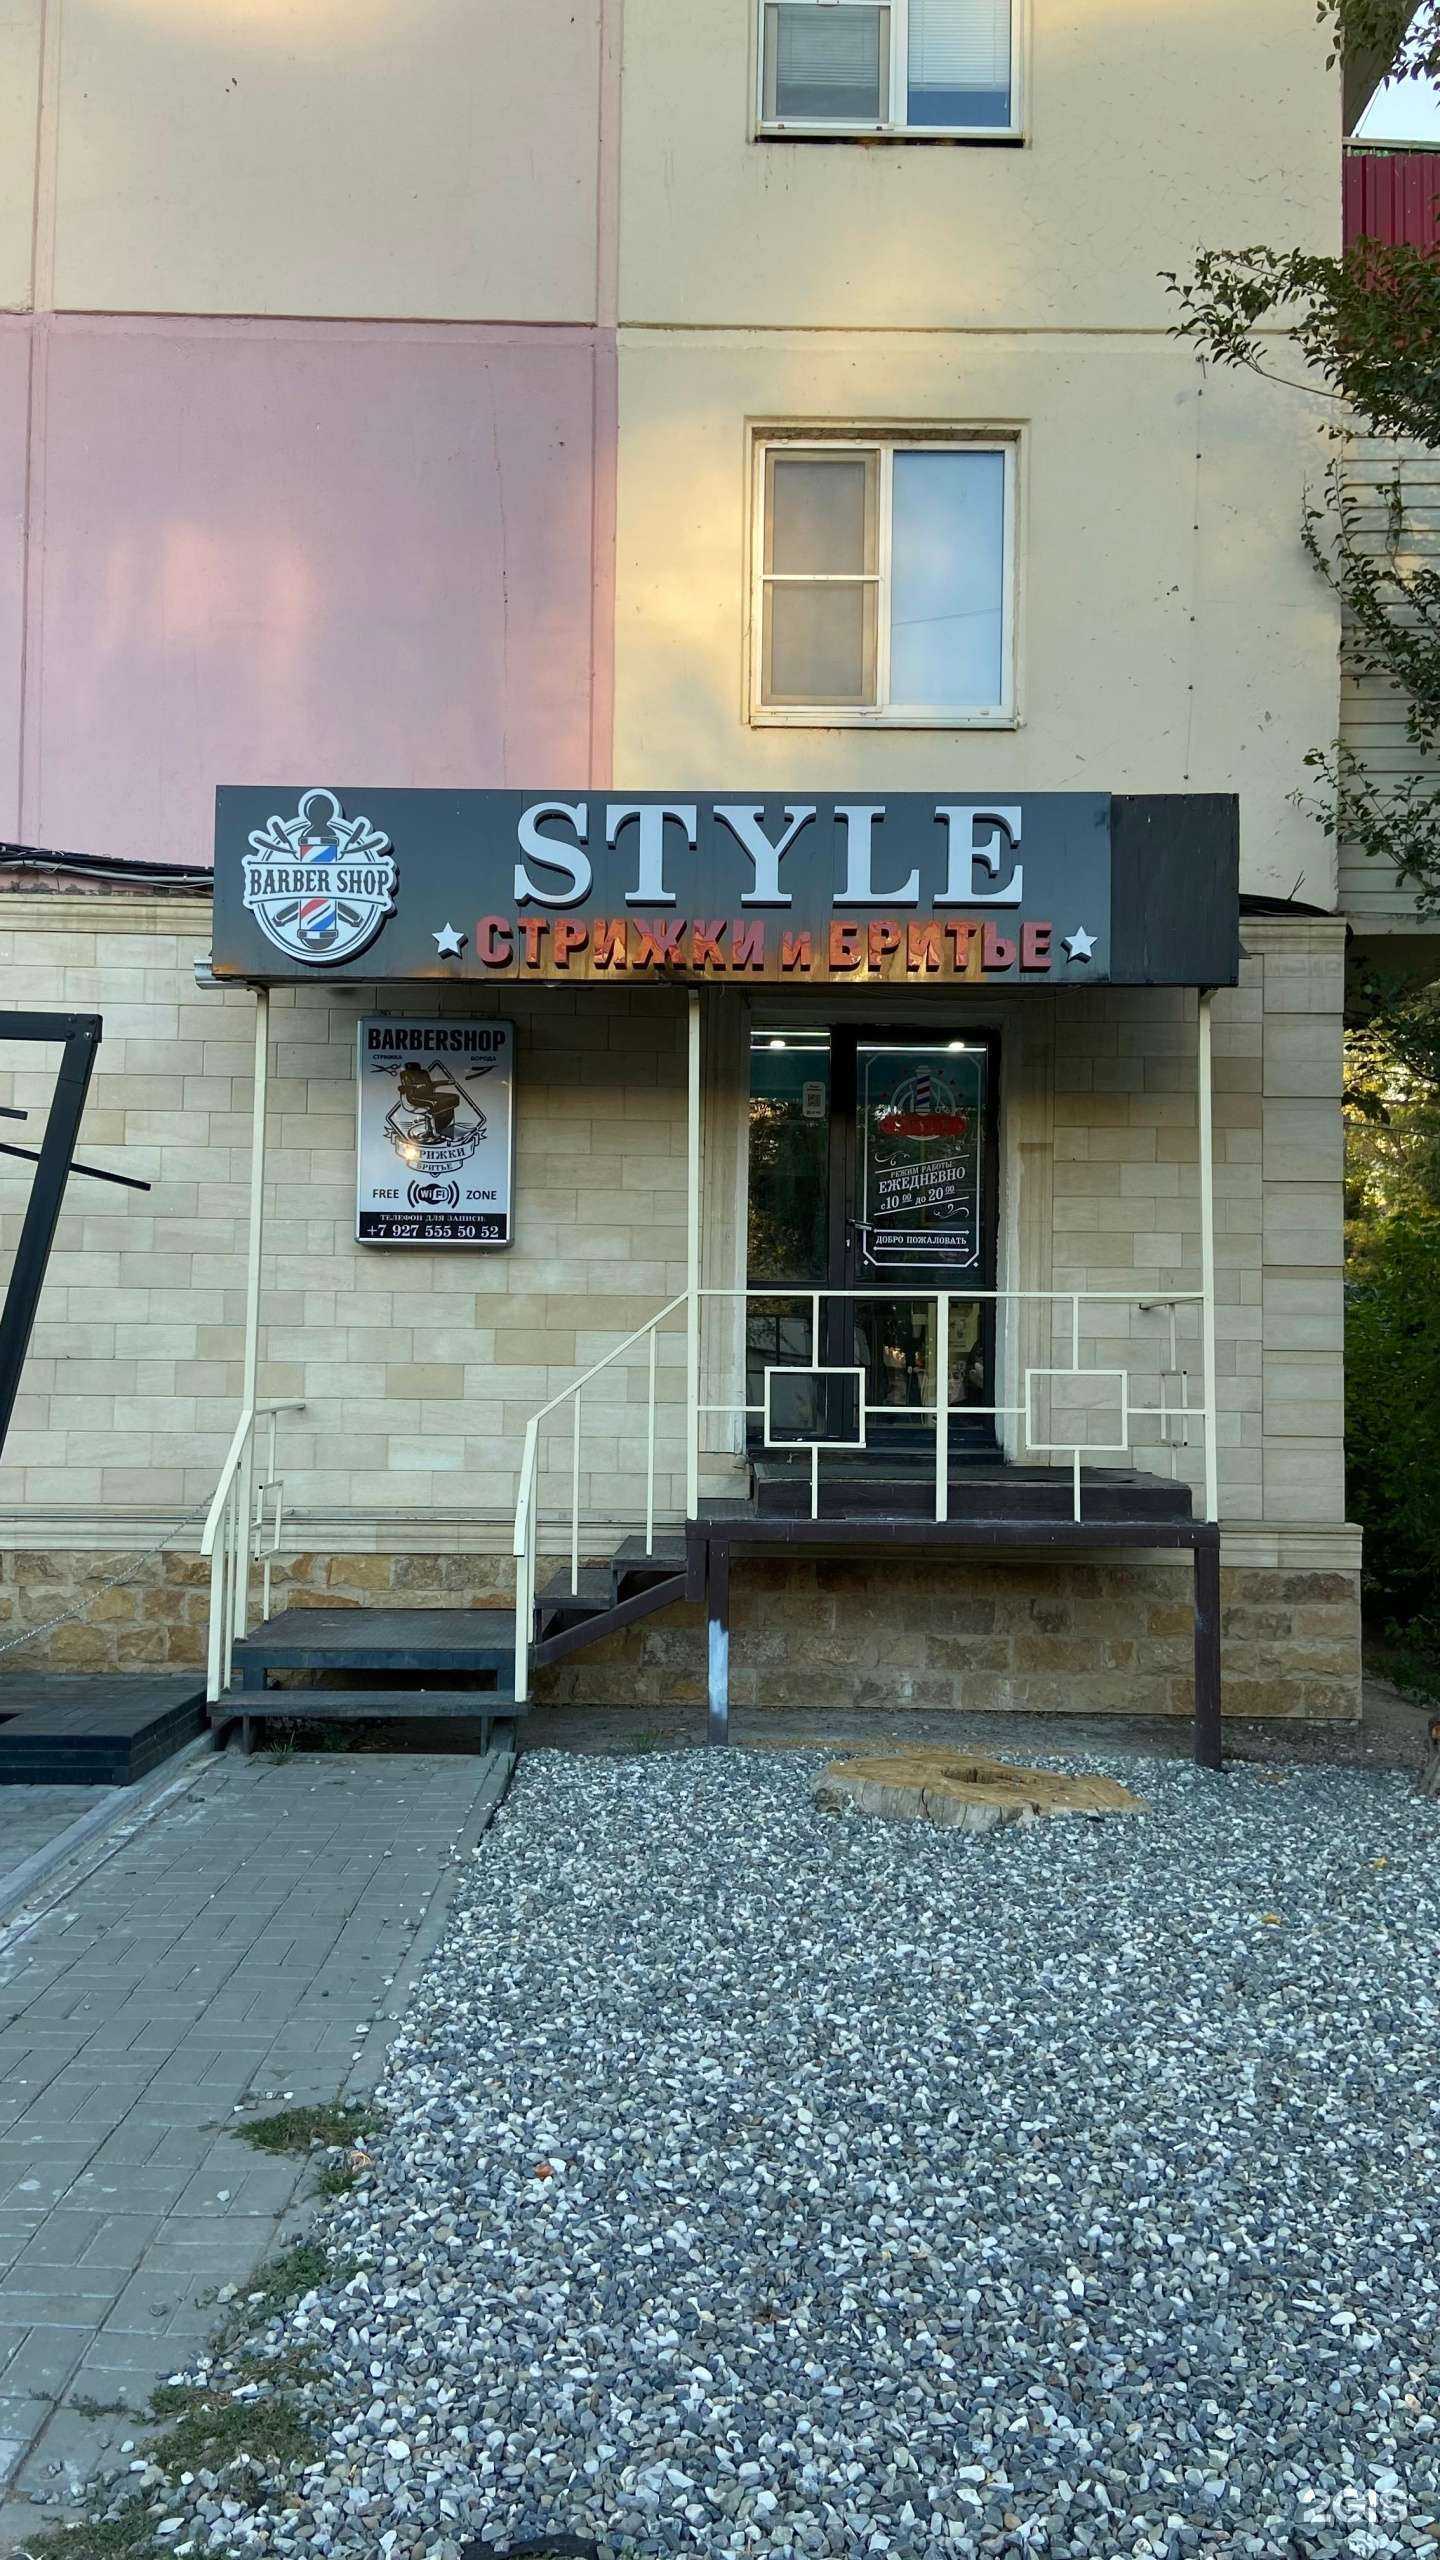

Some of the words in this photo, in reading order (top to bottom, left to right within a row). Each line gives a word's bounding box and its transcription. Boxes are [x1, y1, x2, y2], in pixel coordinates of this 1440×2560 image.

[513, 801, 1023, 905] STYLE
[249, 869, 332, 896] BARBER
[336, 869, 390, 896] SHOP
[475, 915, 765, 971] СТРИЖКИ
[828, 919, 1052, 973] БРИТЬЕ
[367, 1028, 506, 1052] BARBERSHOP
[412, 1147, 466, 1160] РИЖКИ
[890, 1167, 919, 1179] РЕЖИМ
[921, 1160, 953, 1173] РАБОТЫ
[879, 1166, 966, 1194] ЕЖЕДНЕВНО
[372, 1188, 400, 1199] FREE
[466, 1189, 497, 1200] ZONE
[380, 1213, 423, 1222] ТЕЛЕФОН
[425, 1214, 445, 1223] ДЛЯ
[367, 1224, 387, 1237] +7
[391, 1224, 420, 1237] 927
[424, 1225, 452, 1238] 555
[457, 1225, 476, 1238] 50
[480, 1225, 499, 1238] 52
[876, 1235, 904, 1245] ДОБРО
[906, 1235, 967, 1245] ПОЖАЛОВАТЬ
